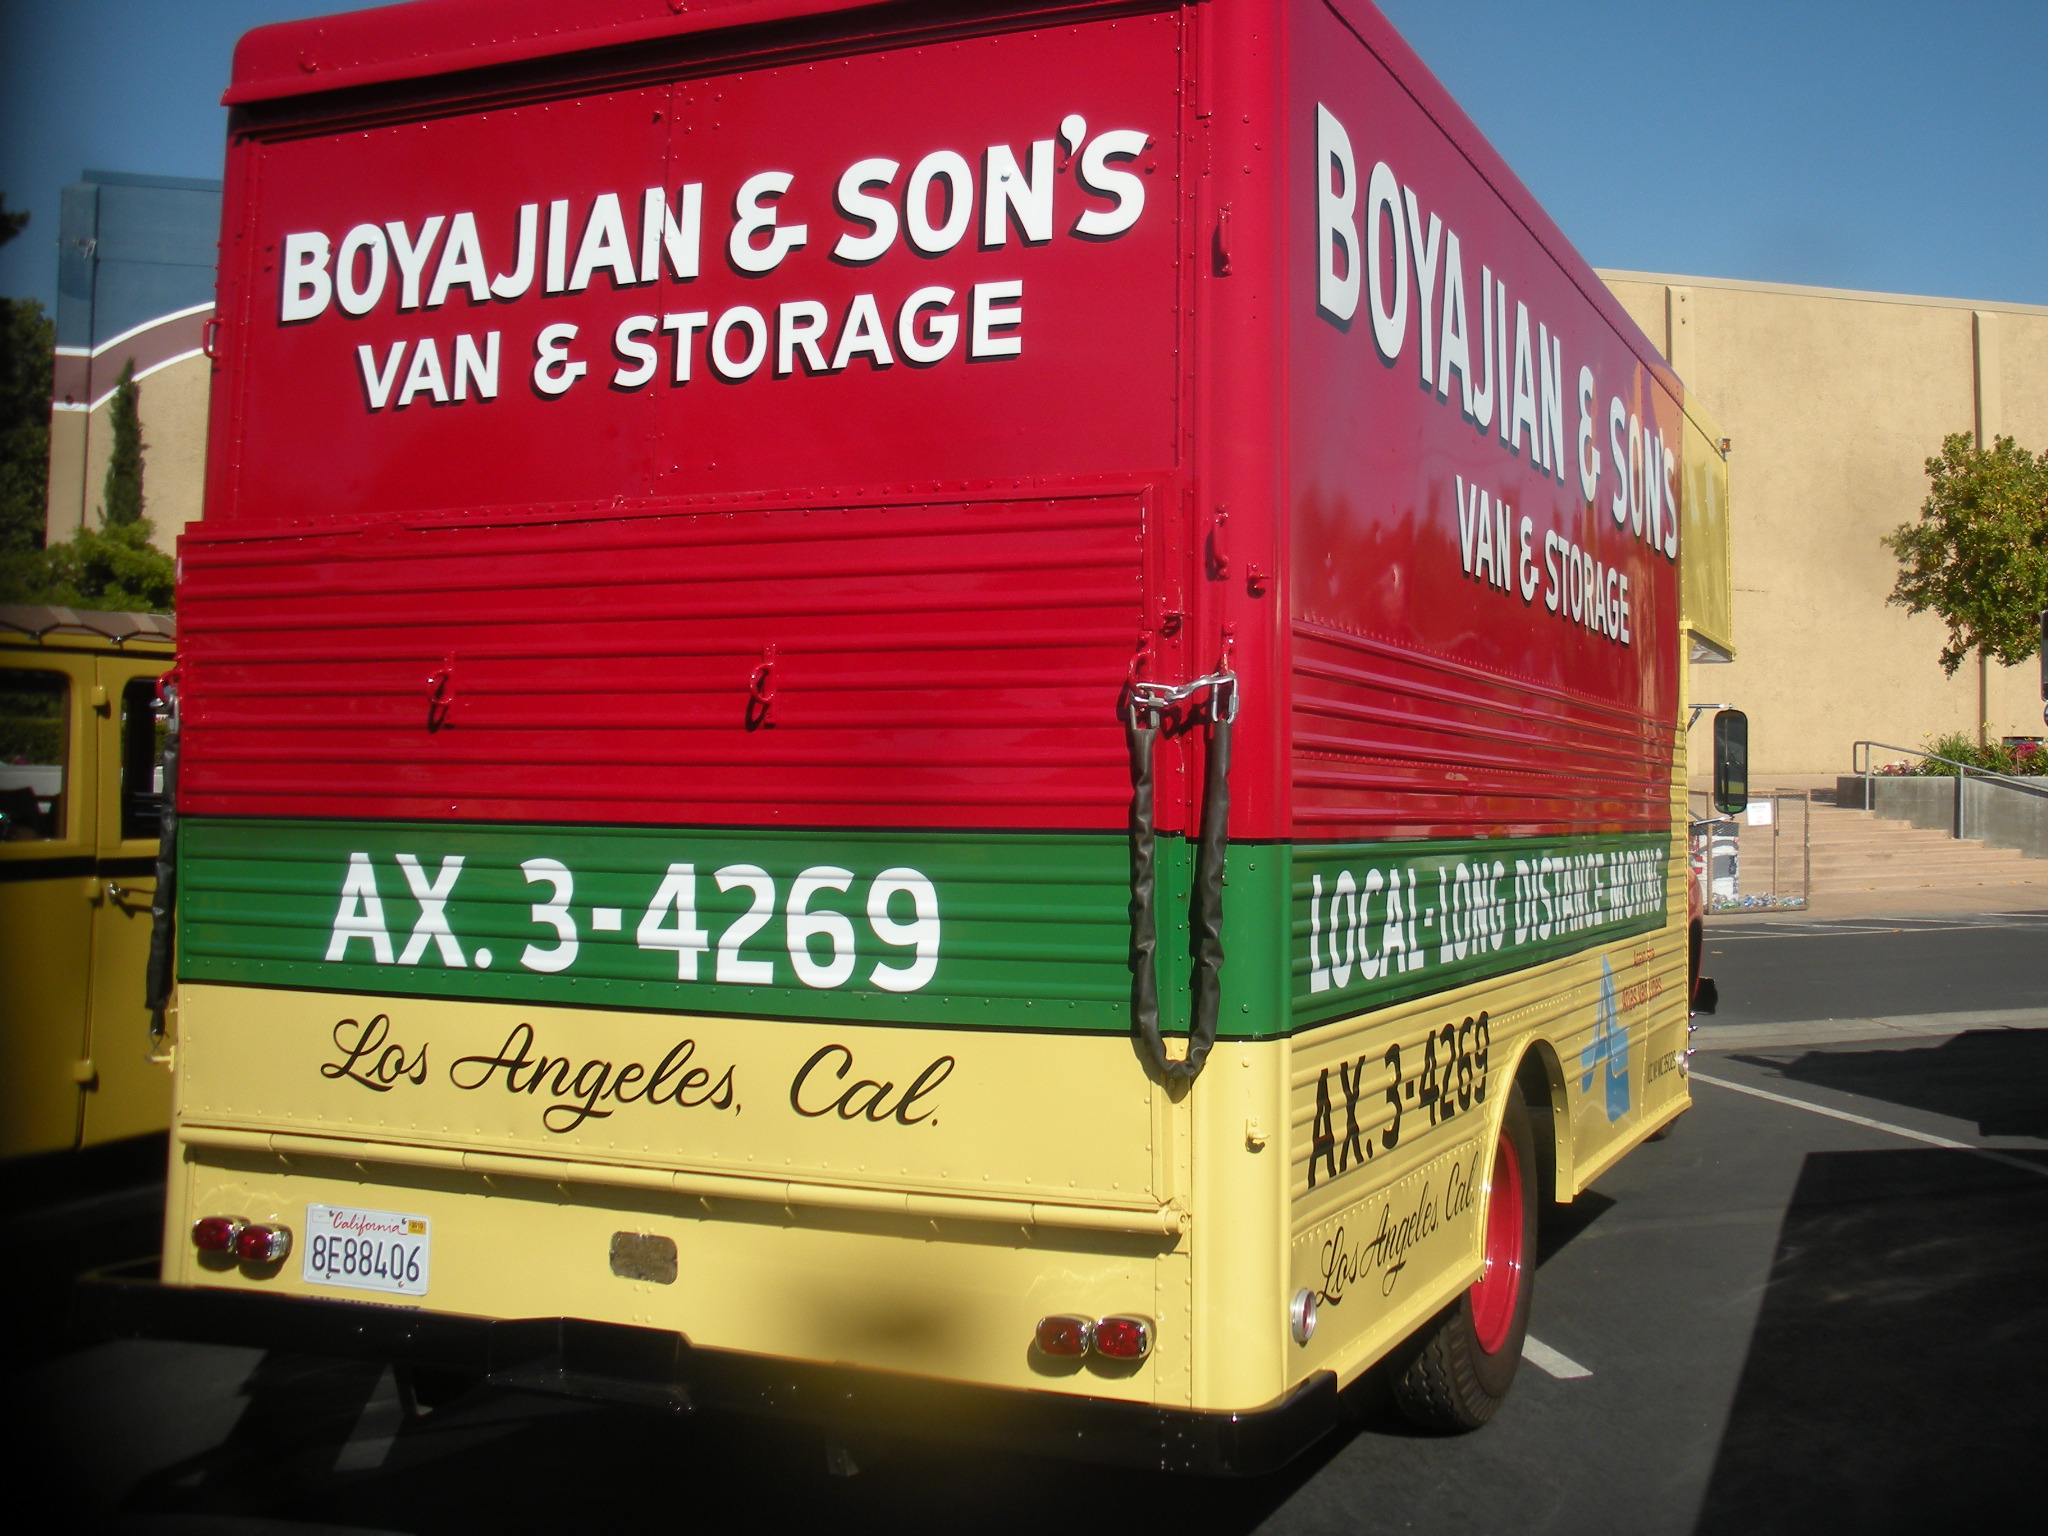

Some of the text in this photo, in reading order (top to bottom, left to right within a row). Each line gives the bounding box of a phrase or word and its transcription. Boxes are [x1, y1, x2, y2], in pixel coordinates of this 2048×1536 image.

[281, 114, 1150, 323] BOYAJIAN & SON'S
[357, 279, 1024, 409] VAN & STORAGE
[1316, 101, 1677, 560] BOYAJIAN & SON'S
[1455, 474, 1629, 646] VAN & STORAGE
[324, 852, 942, 993] AX. 3-4269
[1514, 852, 1605, 946] DISTANCE
[1609, 848, 1664, 922] MOVING
[320, 1013, 956, 1134] Los Angeles, Cal.
[1307, 1010, 1491, 1190] AX. 3-4269
[311, 1233, 421, 1283] 8E88406
[333, 1210, 408, 1237] California
[1315, 1150, 1480, 1306] Los Angeles, Cal.
